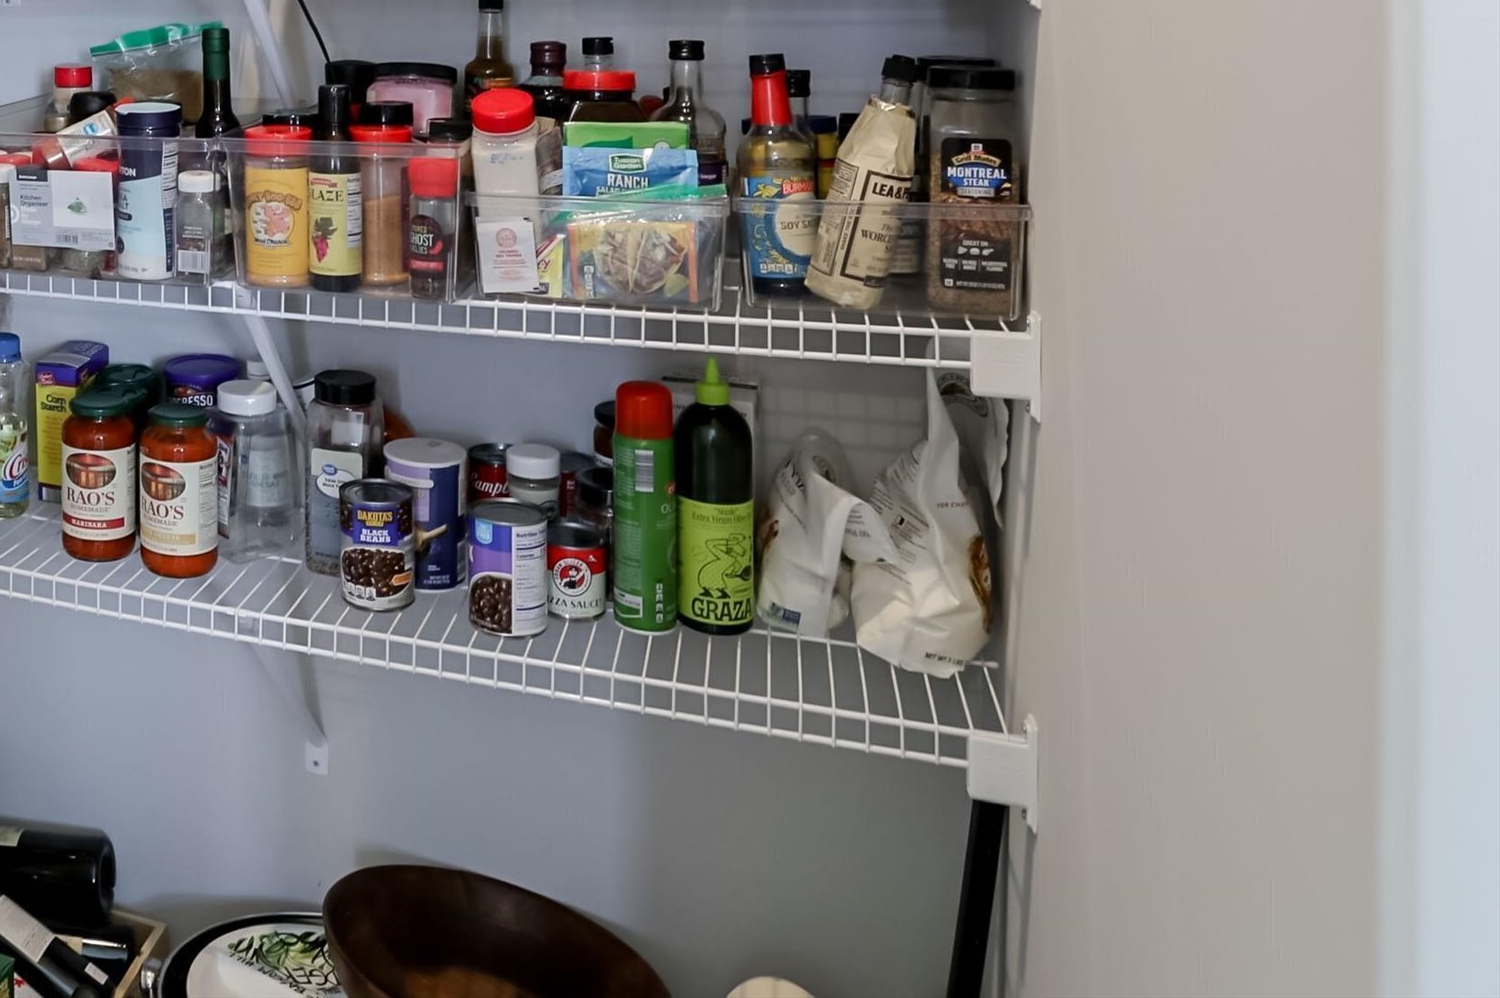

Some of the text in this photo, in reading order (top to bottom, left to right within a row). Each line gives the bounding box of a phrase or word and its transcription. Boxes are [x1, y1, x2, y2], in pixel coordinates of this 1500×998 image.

[947, 166, 1007, 180] MONTREAL
[607, 173, 648, 189] RANCH
[963, 179, 990, 187] STEAK
[780, 219, 800, 231] SOY
[45, 394, 67, 404] Corn
[40, 402, 67, 413] Starch
[66, 486, 115, 507] RAO'S
[142, 498, 184, 520] RAO'S
[357, 510, 393, 522] DAKOTA'S
[710, 514, 733, 525] Virgin
[71, 518, 107, 529] MARINARA
[361, 528, 389, 536] BLACK
[360, 535, 391, 543] BEANS
[691, 597, 753, 622] GRAZA
